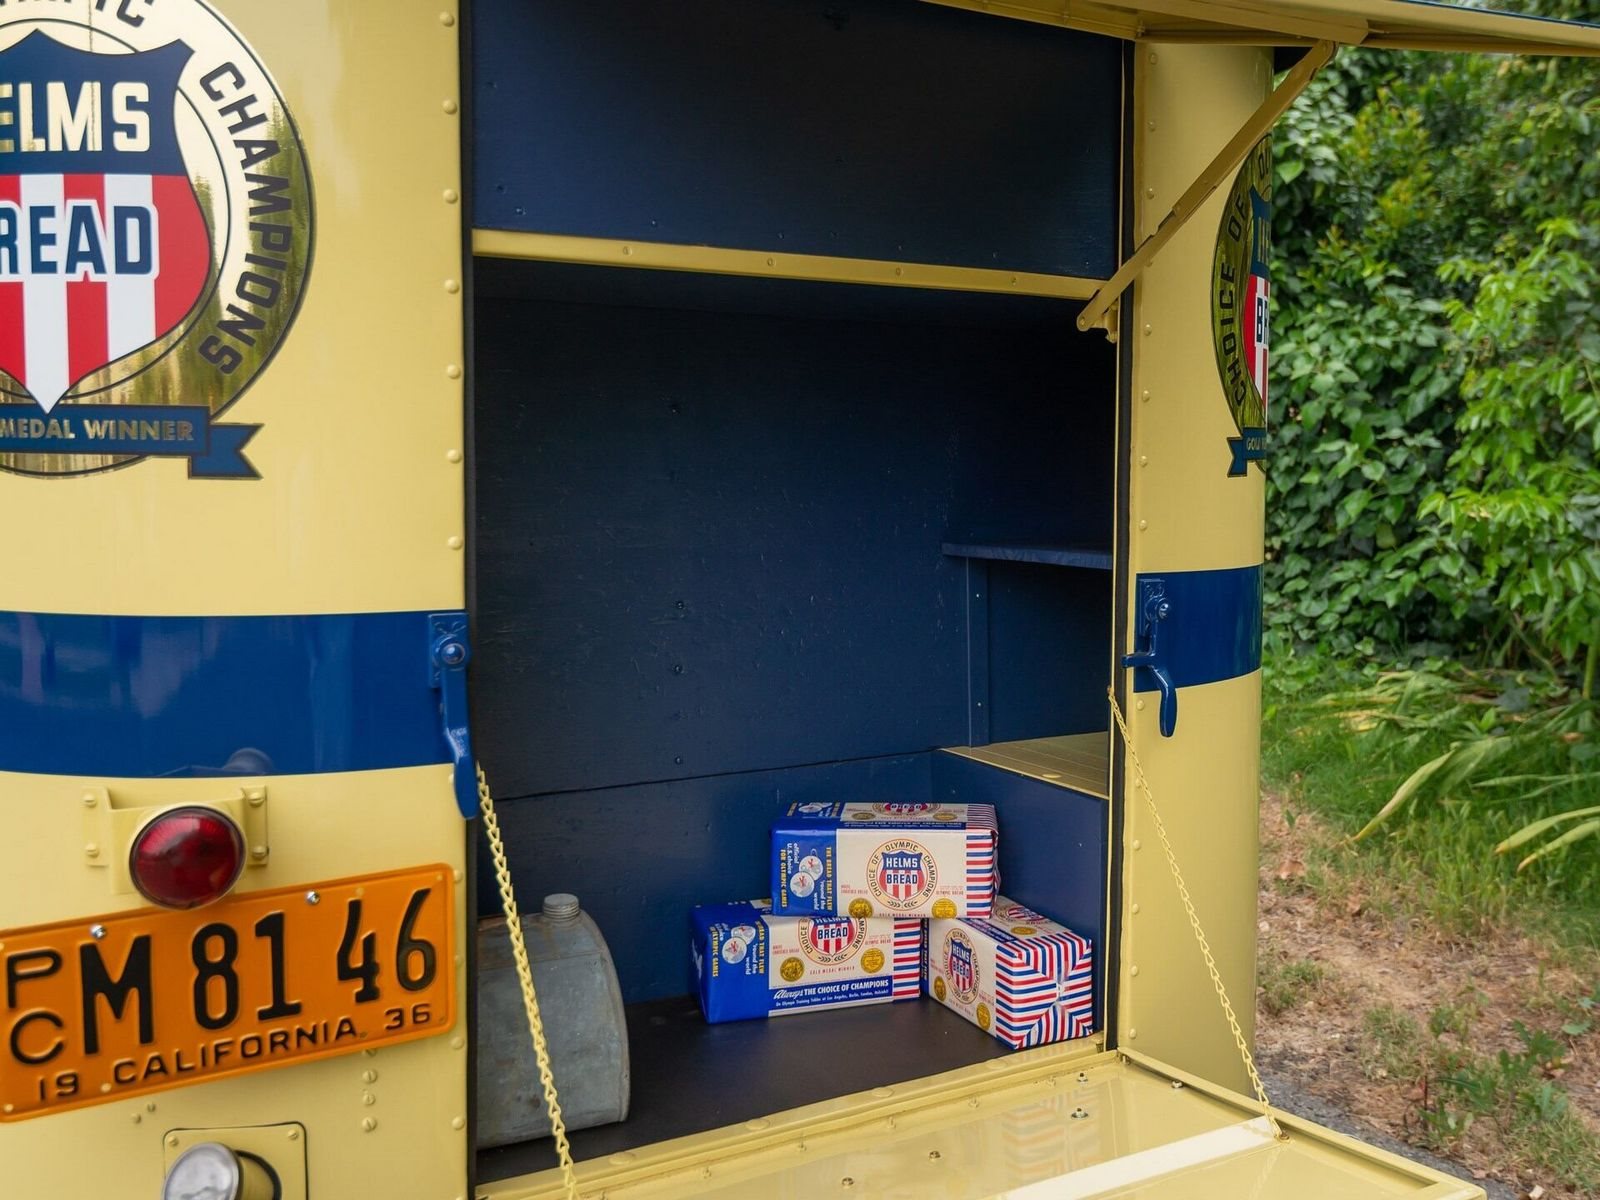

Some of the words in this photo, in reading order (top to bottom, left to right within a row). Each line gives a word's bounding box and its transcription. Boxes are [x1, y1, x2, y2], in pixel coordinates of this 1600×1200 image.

[199, 62, 293, 374] CHAMPIONS
[1228, 193, 1246, 242] OF
[1219, 262, 1246, 406] CHOICE
[0, 418, 75, 439] MEDAL
[83, 419, 194, 441] WINNER
[885, 842, 919, 852] OLYMPIC
[872, 854, 880, 865] OF
[886, 857, 918, 868] HELMS
[869, 869, 882, 897] CHOICE
[886, 874, 918, 885] BREAD
[923, 855, 936, 897] CHAMPIONS
[800, 926, 813, 954] CHOICE
[853, 917, 865, 949] MPIONS
[817, 927, 848, 940] BREAD
[952, 943, 970, 962] HELMS
[773, 989, 804, 1000] Always
[804, 988, 816, 996] THE
[817, 985, 841, 994] CHOICE
[850, 979, 889, 991] CHAMPIONS
[39, 1072, 79, 1103] 19
[113, 1017, 358, 1085] CALIFORNIA
[384, 1003, 432, 1031] 36
